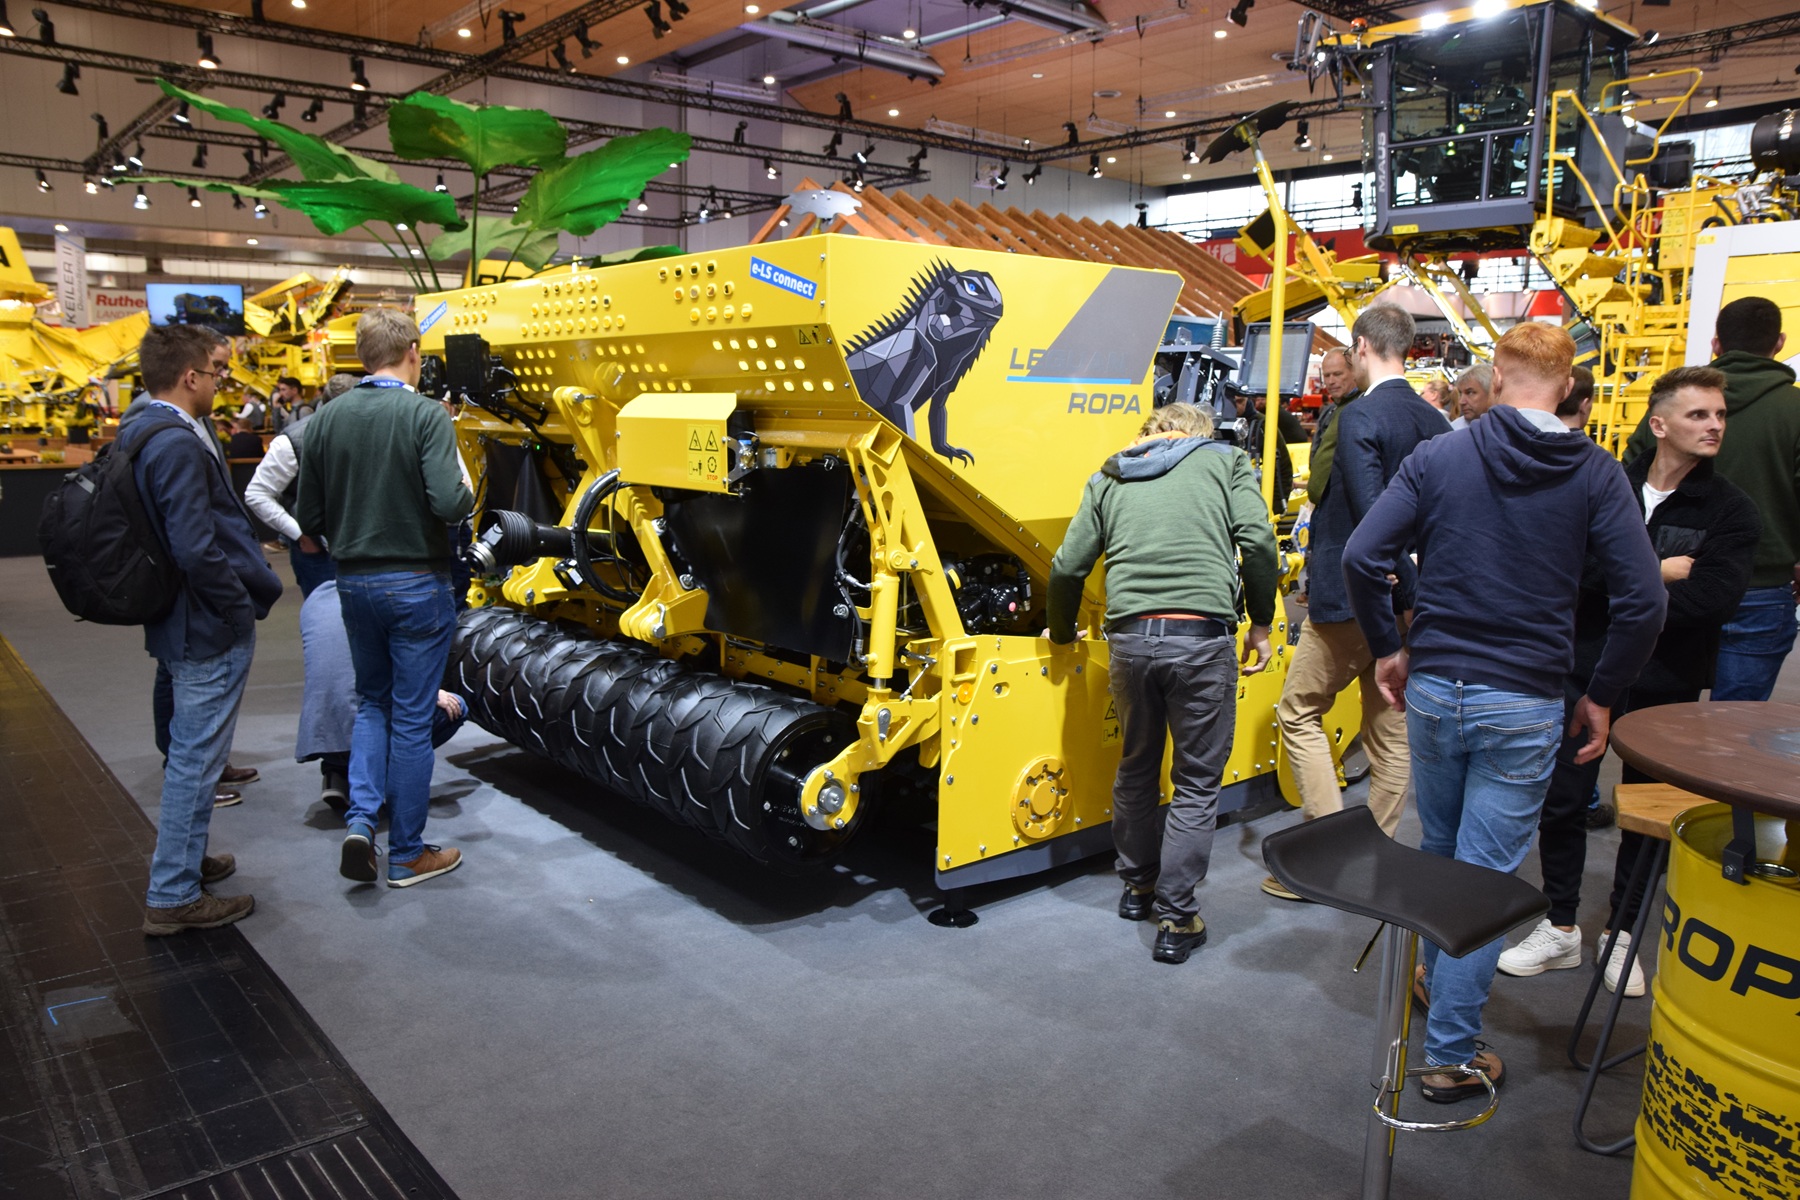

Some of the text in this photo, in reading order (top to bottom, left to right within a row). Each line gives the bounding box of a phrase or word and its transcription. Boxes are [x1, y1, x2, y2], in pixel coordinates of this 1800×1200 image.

[1377, 131, 1387, 192] MAUS
[63, 261, 76, 325] KEILER
[751, 262, 814, 297] e-LS connect
[96, 294, 148, 308] Ruthe
[1009, 347, 1127, 374] LEGUAN
[1067, 392, 1141, 415] ROPA
[1662, 893, 1800, 1016] ROP
